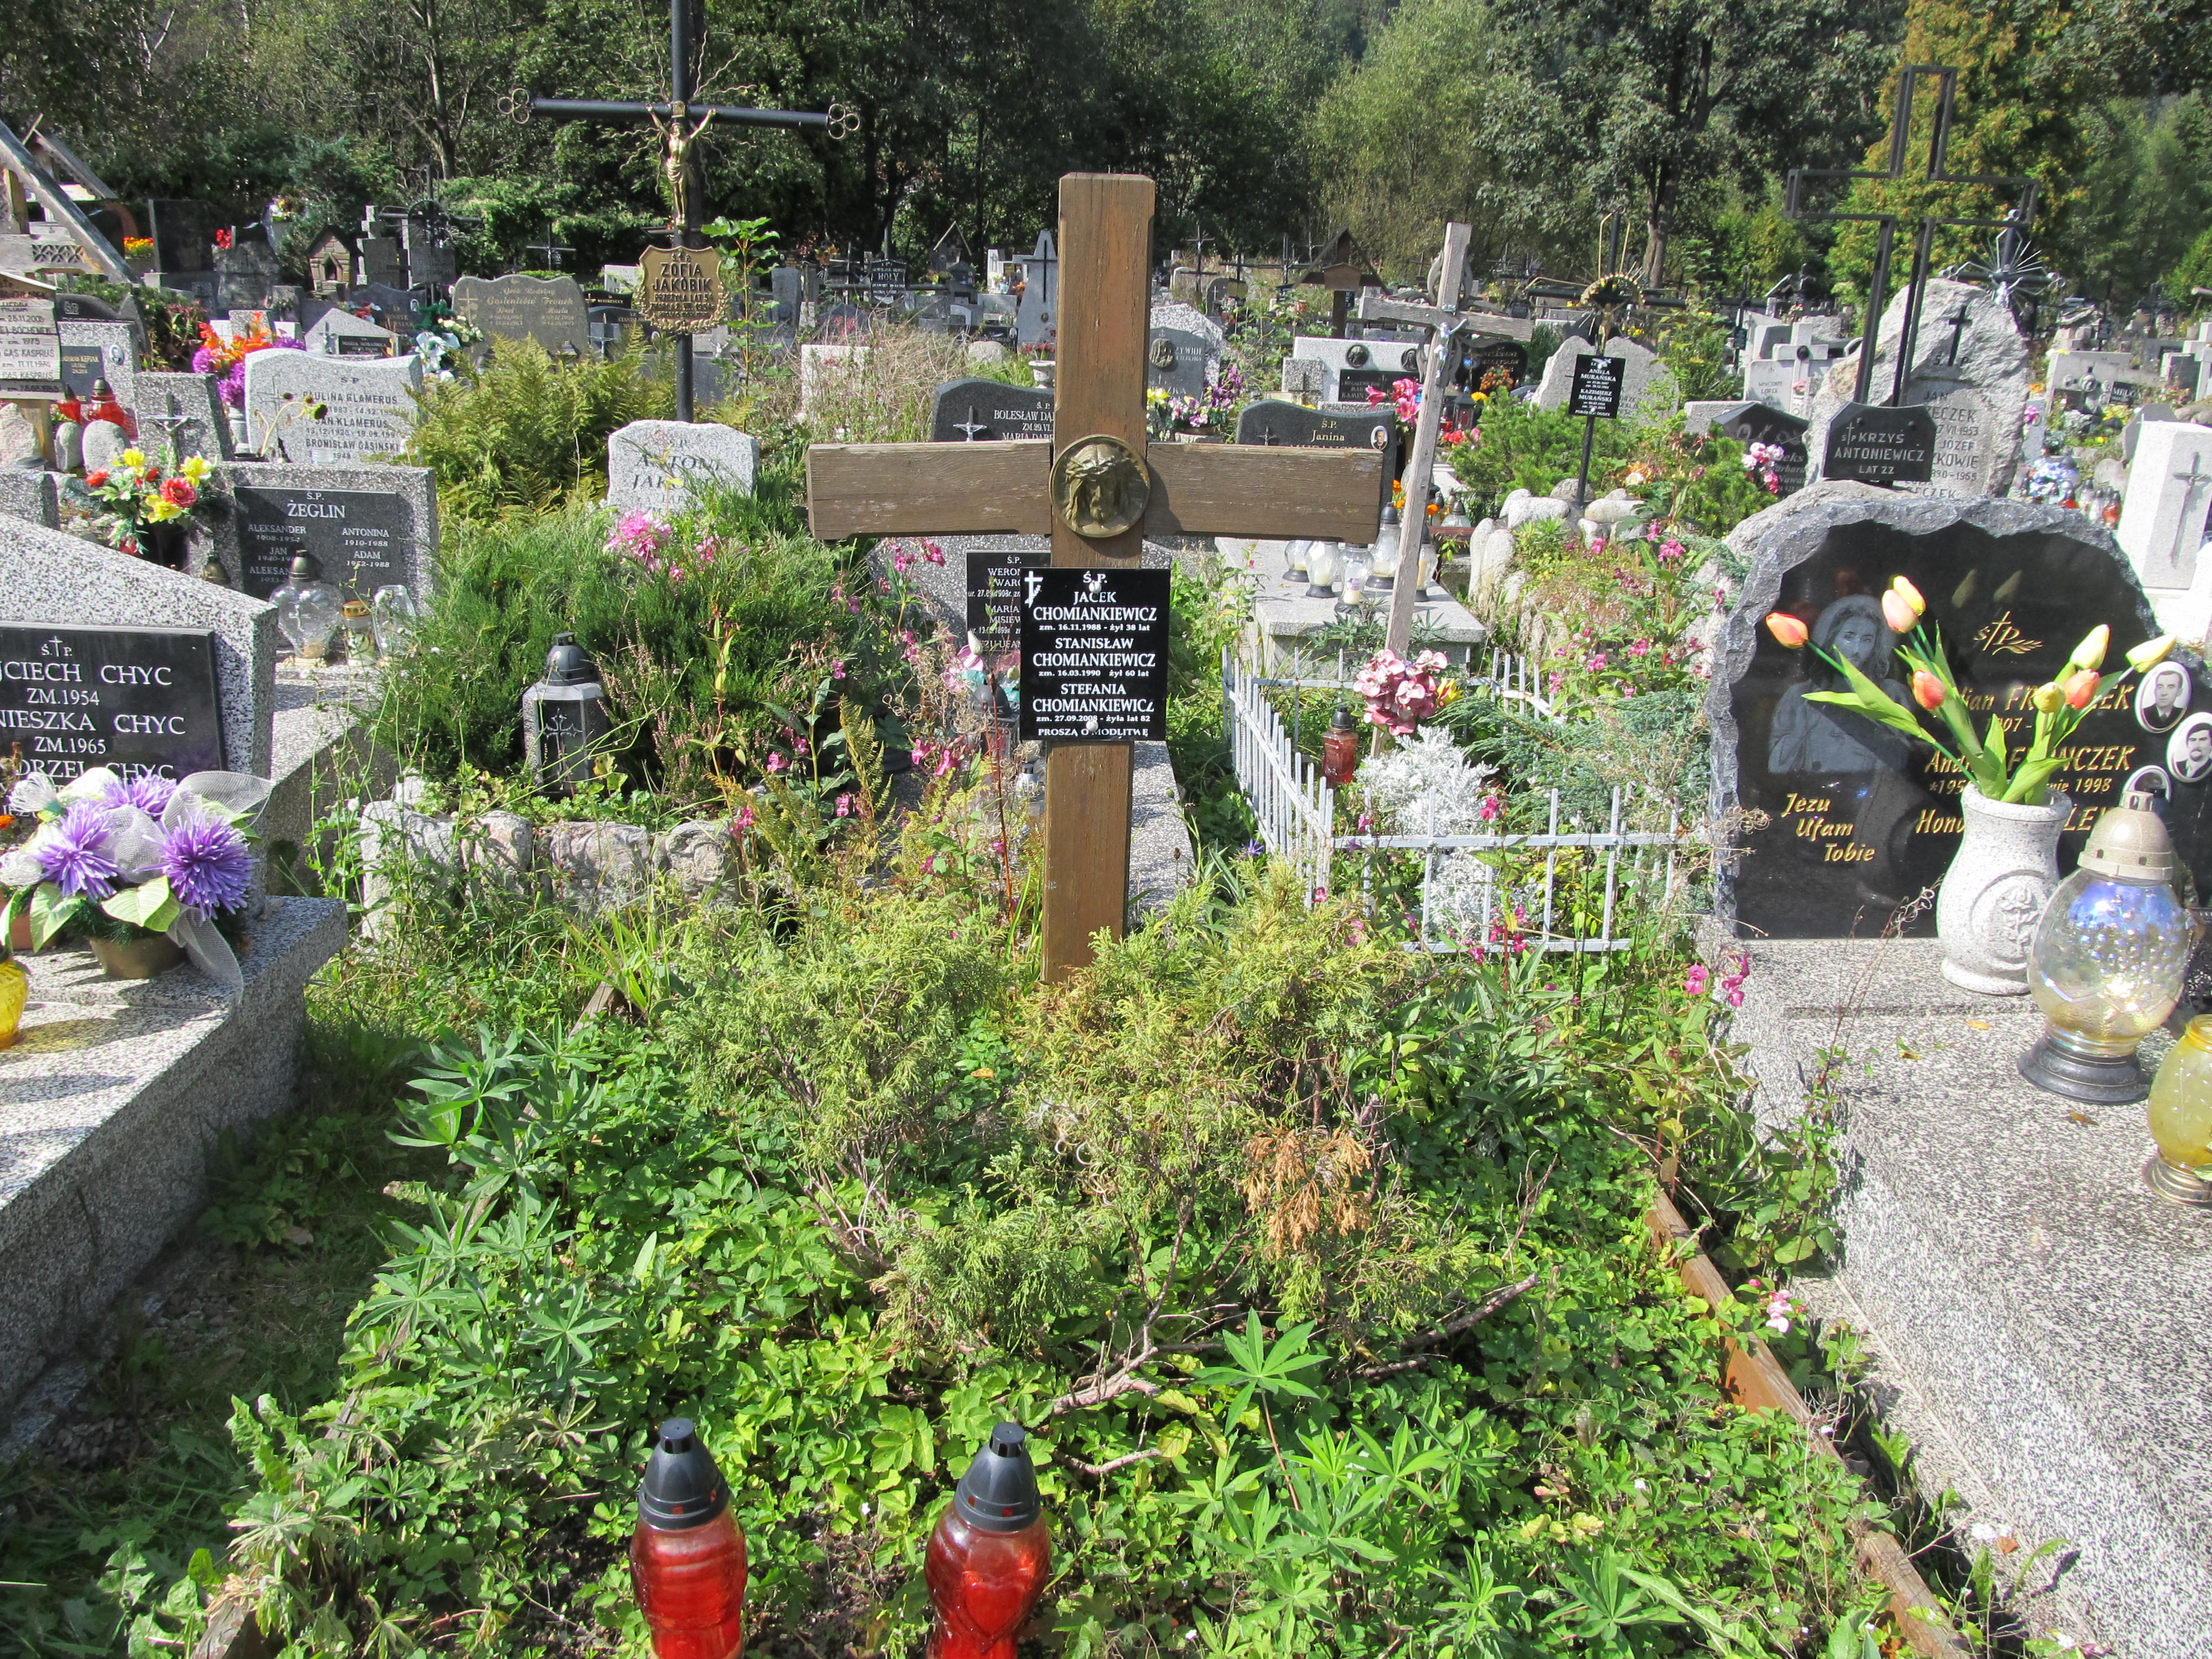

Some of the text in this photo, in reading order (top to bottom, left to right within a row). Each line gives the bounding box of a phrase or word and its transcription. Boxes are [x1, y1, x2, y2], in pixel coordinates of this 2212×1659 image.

[660, 262, 703, 278] ZOFIA
[993, 409, 1039, 420] BOLESŁAW
[337, 418, 388, 429] KLAMERUS
[1311, 429, 1345, 442] Janina
[1859, 465, 1895, 474] LAT 22
[286, 499, 346, 519] ŻEGLIN
[248, 524, 390, 538] ALEKSANDER ANTONINA
[345, 539, 388, 547] 1910-1988
[269, 546, 381, 560] JAN ADAM
[1073, 591, 1117, 605] JACEK
[1033, 606, 1157, 622] CHOMIANKIEWICZ
[1110, 623, 1124, 633] żył
[1139, 623, 1150, 632] lat
[41, 643, 72, 656] Ś. P.
[1055, 638, 1134, 649] STANISŁAW
[1032, 653, 1156, 667] CHOMIANKIEWICZ
[100, 664, 173, 686] CHYC
[1109, 670, 1123, 679] żył
[27, 687, 101, 706] ZM.1954
[1061, 684, 1127, 695] STEFANIA
[113, 713, 186, 735] CHYC
[1106, 715, 1125, 724] żyła
[1038, 728, 1078, 737] PROSZĄ
[34, 735, 107, 755] ZM.1965
[2075, 777, 2112, 794] 1998
[1781, 792, 1832, 818] Jezu
[1796, 817, 1854, 842] Ufam
[1824, 842, 1877, 863] Tobie
